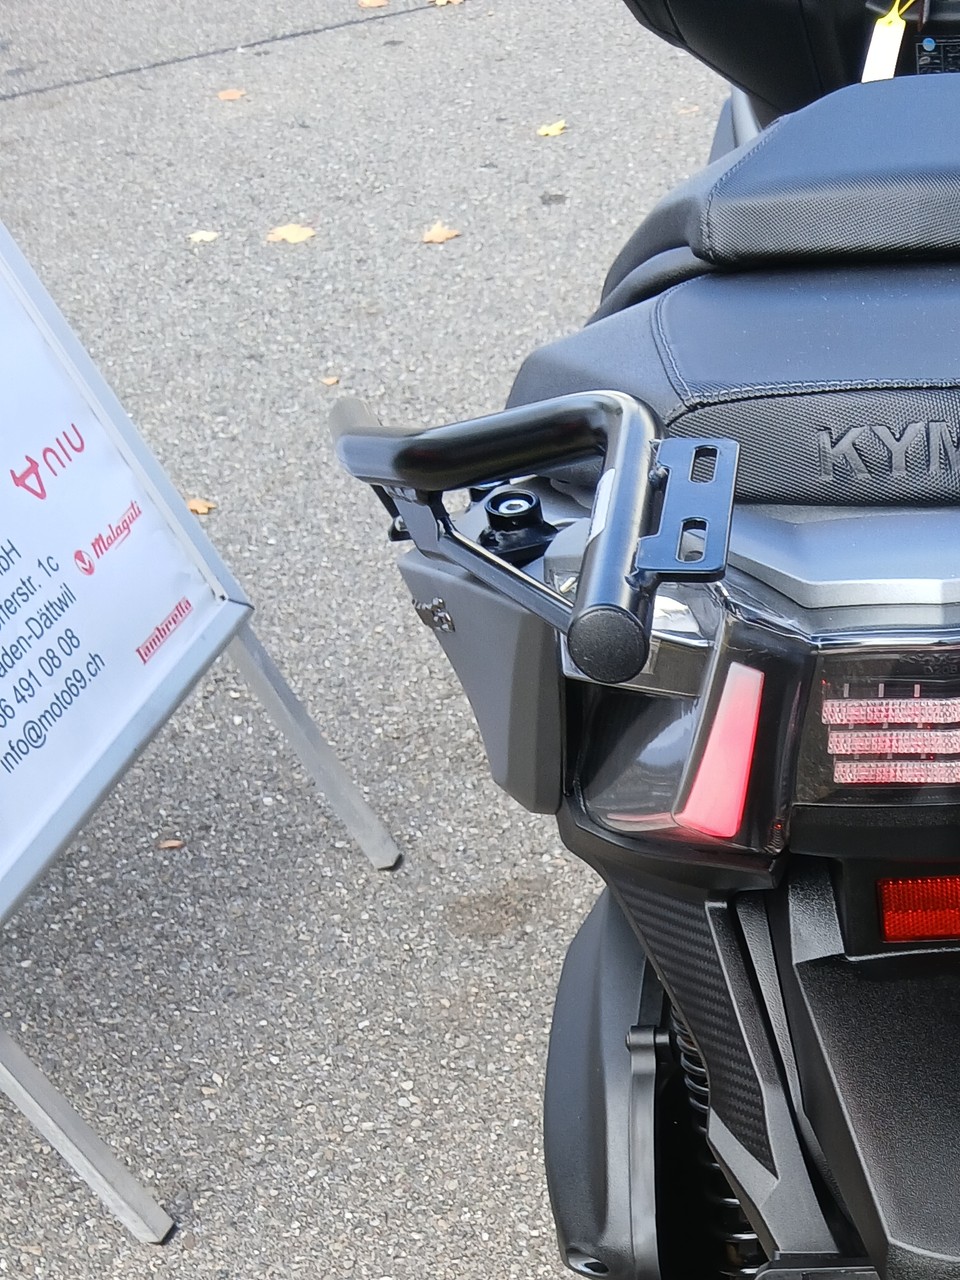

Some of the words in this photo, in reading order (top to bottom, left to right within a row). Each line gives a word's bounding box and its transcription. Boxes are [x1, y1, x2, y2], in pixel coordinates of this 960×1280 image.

[91, 500, 142, 559] Malaguti
[0, 576, 42, 630] ferstr.
[37, 556, 59, 578] 1c
[13, 668, 42, 704] 491
[38, 648, 62, 677] 08
[57, 628, 80, 656] 08
[0, 653, 106, 774] info@moto69.ch
